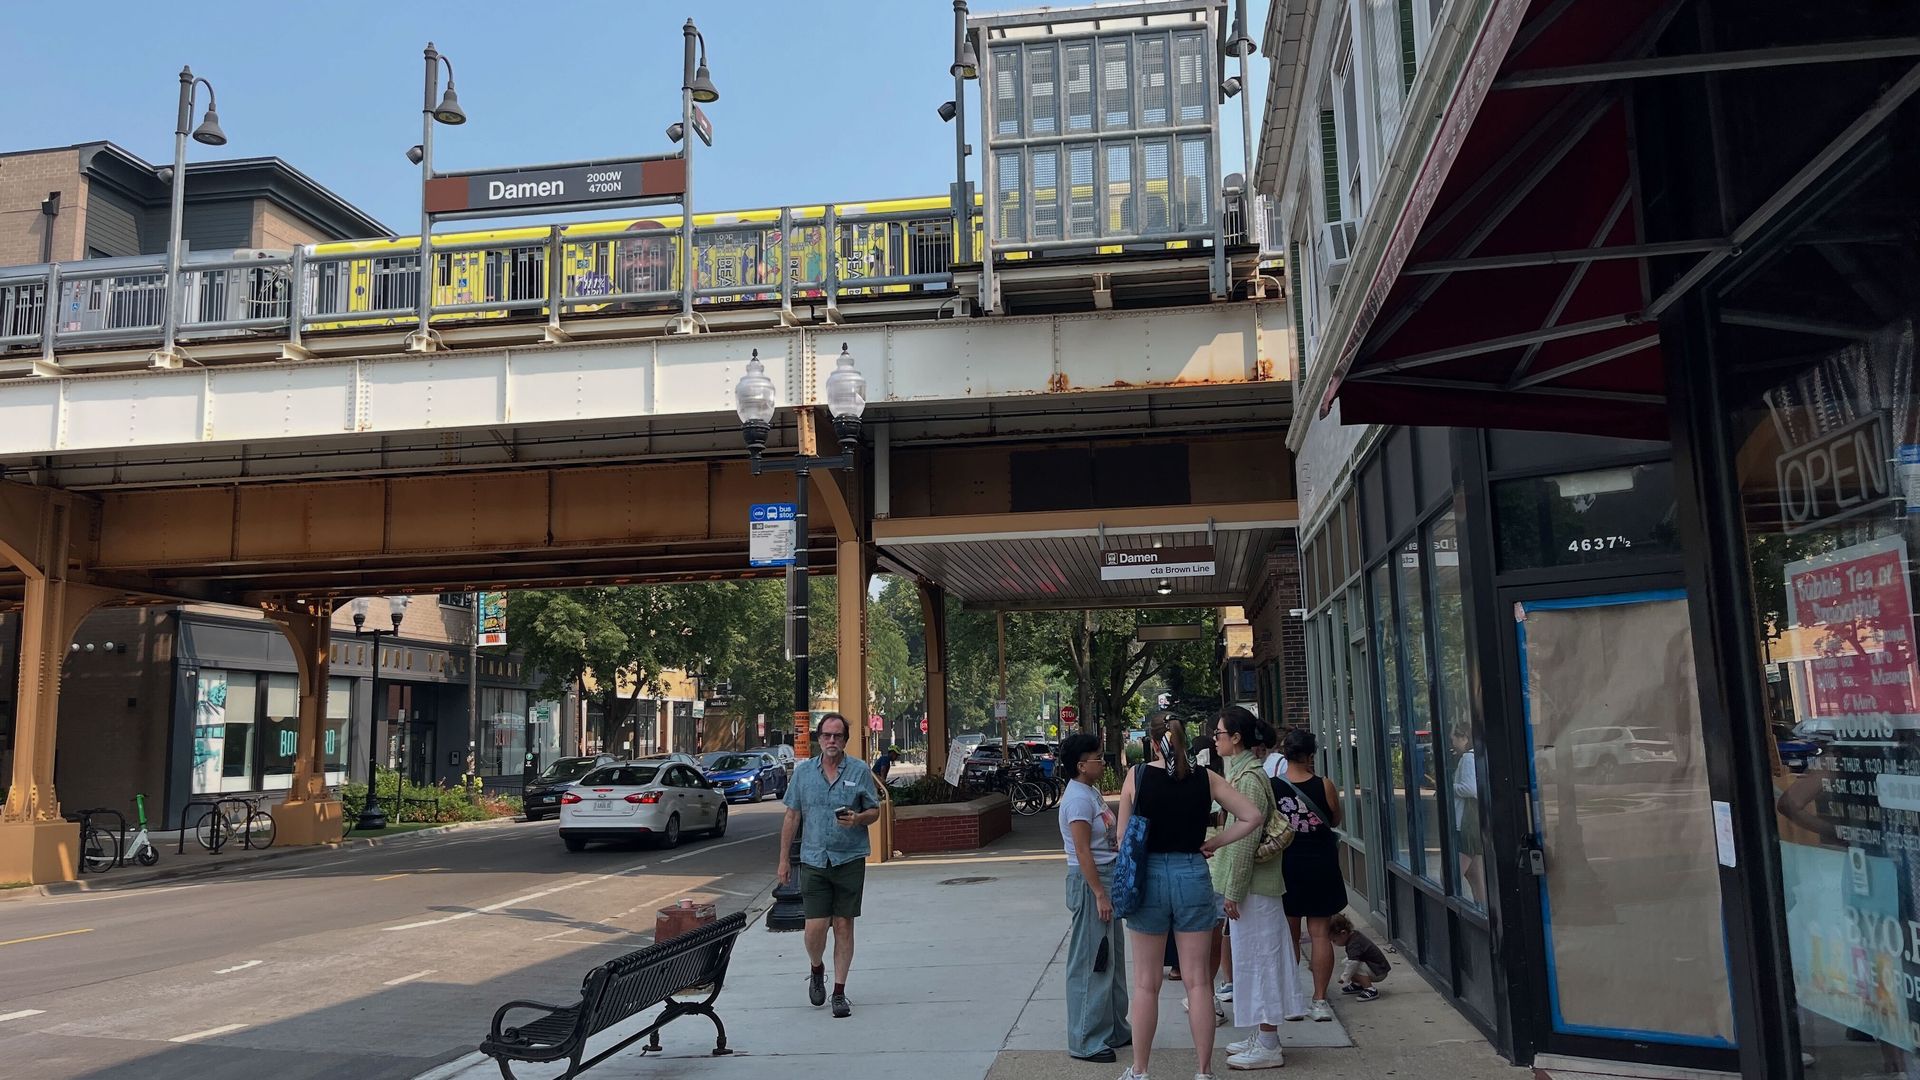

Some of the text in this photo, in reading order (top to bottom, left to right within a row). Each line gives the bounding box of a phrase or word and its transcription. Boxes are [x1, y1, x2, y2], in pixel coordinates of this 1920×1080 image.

[586, 170, 622, 183] 2000W
[488, 180, 564, 201] Damen
[588, 181, 622, 193] 4700N
[1784, 422, 1887, 523] OPEN
[1120, 553, 1158, 564] Damen
[1150, 564, 1210, 575] cta Brown Line
[1835, 712, 1894, 738] HOURS
